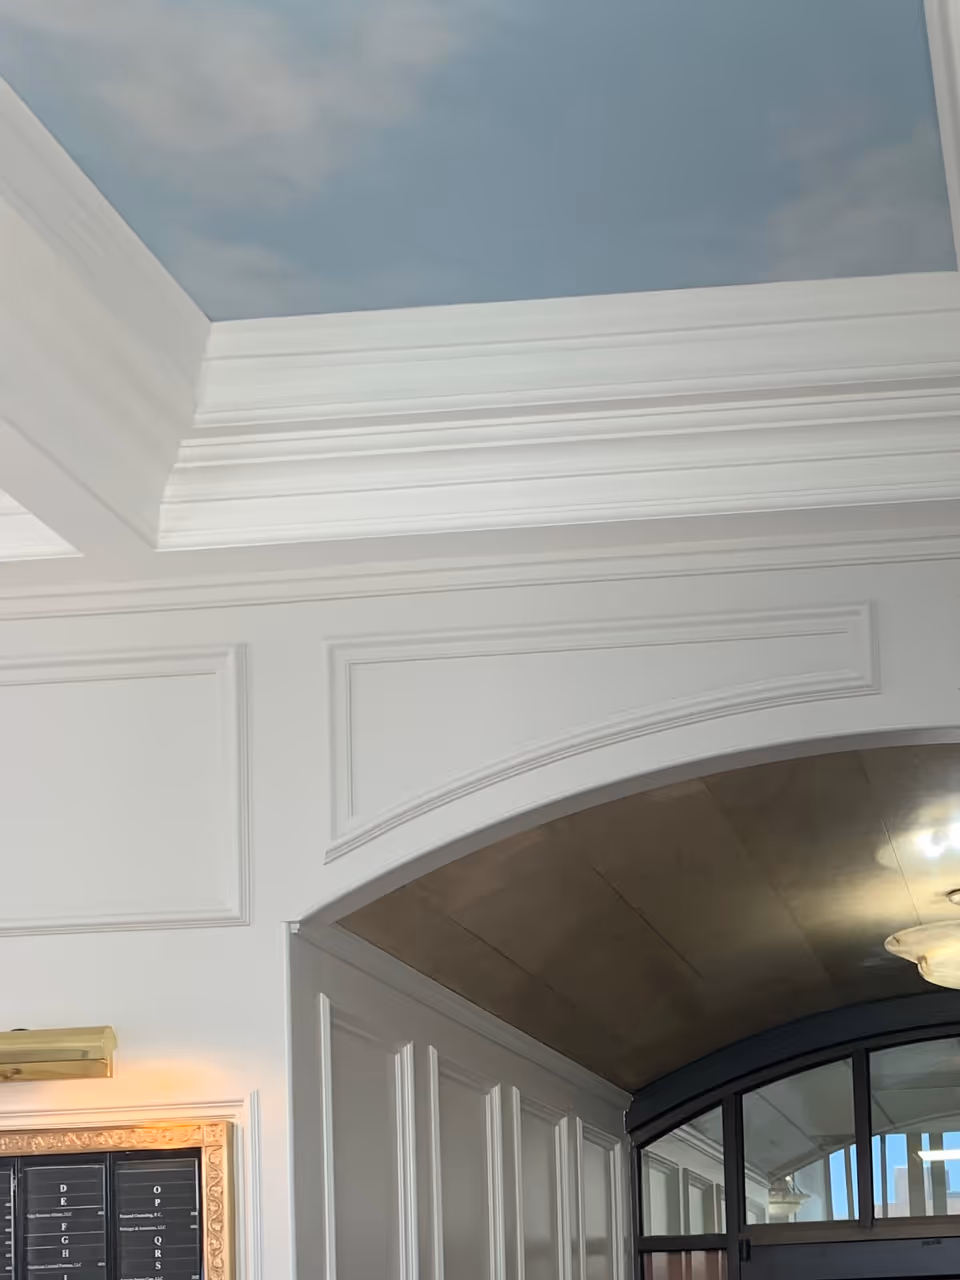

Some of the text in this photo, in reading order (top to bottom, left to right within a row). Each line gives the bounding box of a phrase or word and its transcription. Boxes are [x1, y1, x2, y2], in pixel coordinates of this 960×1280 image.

[60, 1184, 67, 1192] D
[153, 1186, 161, 1194] O
[61, 1197, 67, 1205] E
[155, 1199, 161, 1207] P
[61, 1223, 68, 1231] F
[61, 1236, 69, 1244] G
[154, 1236, 162, 1245] Q
[62, 1249, 69, 1258] H
[154, 1249, 162, 1257] R
[155, 1262, 161, 1270] S
